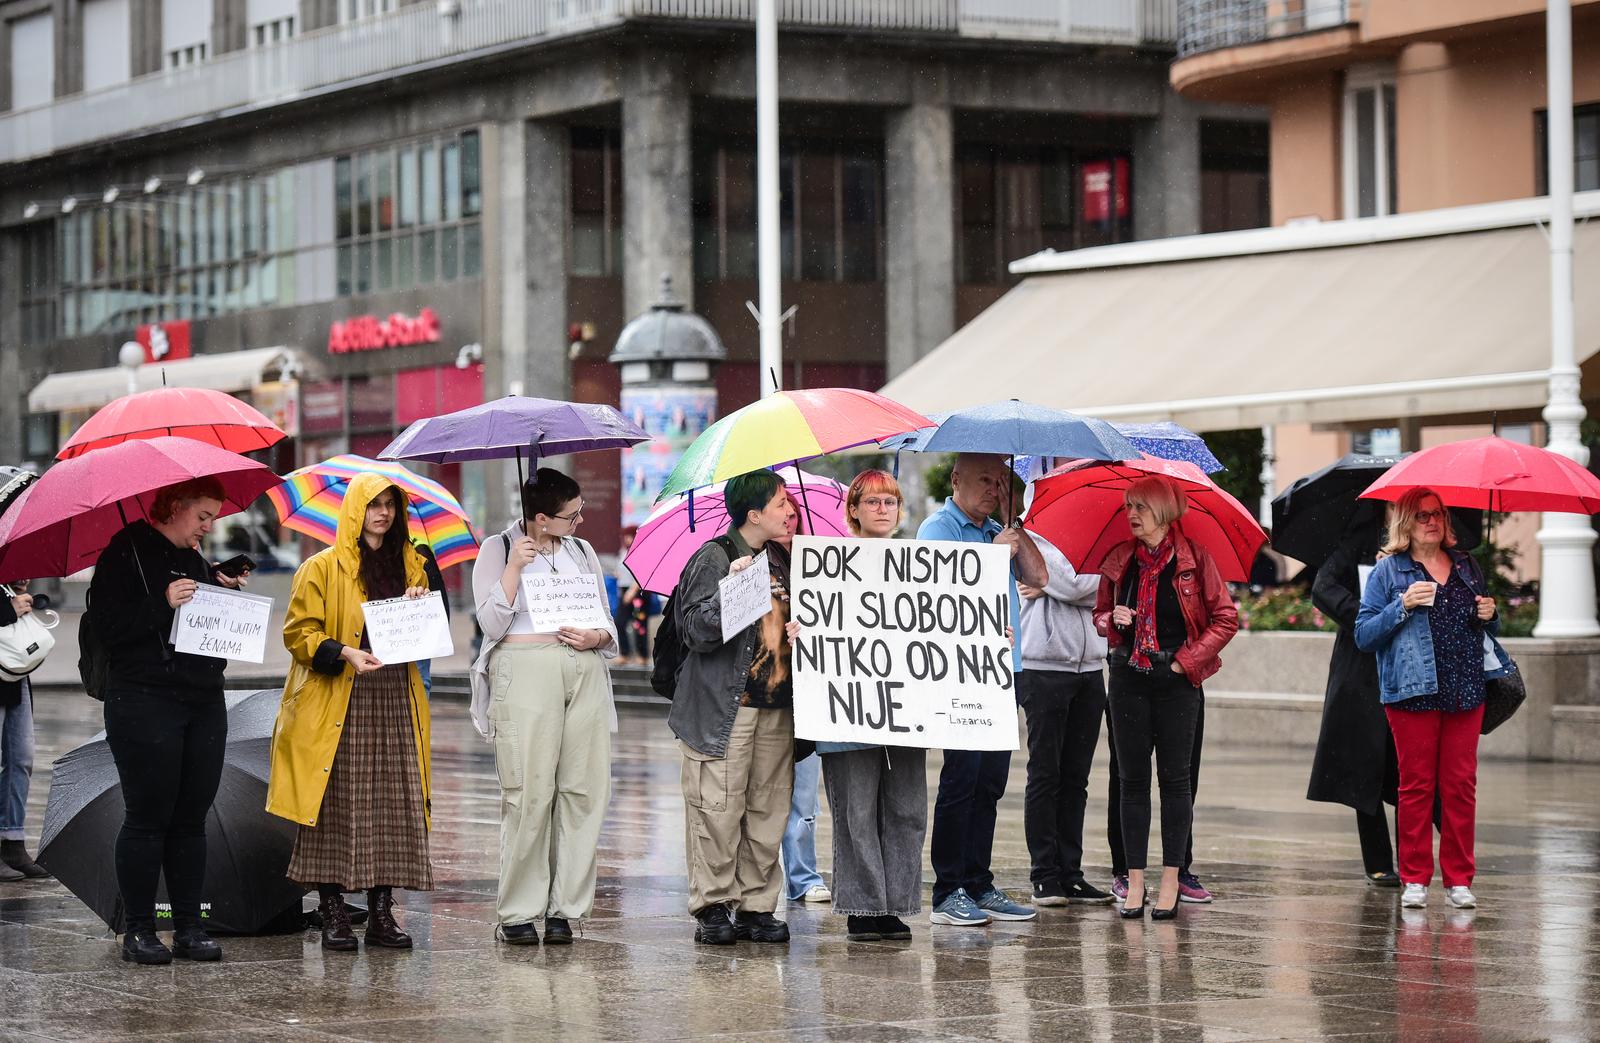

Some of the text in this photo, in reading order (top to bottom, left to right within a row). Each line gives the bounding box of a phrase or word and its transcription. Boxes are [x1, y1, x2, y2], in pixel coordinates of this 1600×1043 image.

[801, 545, 981, 586] DOK NISMO
[526, 579, 546, 588] MOJ
[532, 592, 599, 601] JE SVAKA OSOBA
[186, 612, 262, 636] GLASNIM I LJUTIM
[796, 589, 843, 631] SVI
[856, 591, 1009, 638] SLOBODNI
[199, 632, 243, 655] ŽENAMA
[795, 635, 1013, 690] NITKO OD NAS
[828, 680, 925, 733] NIJE.
[951, 698, 983, 710] Emma
